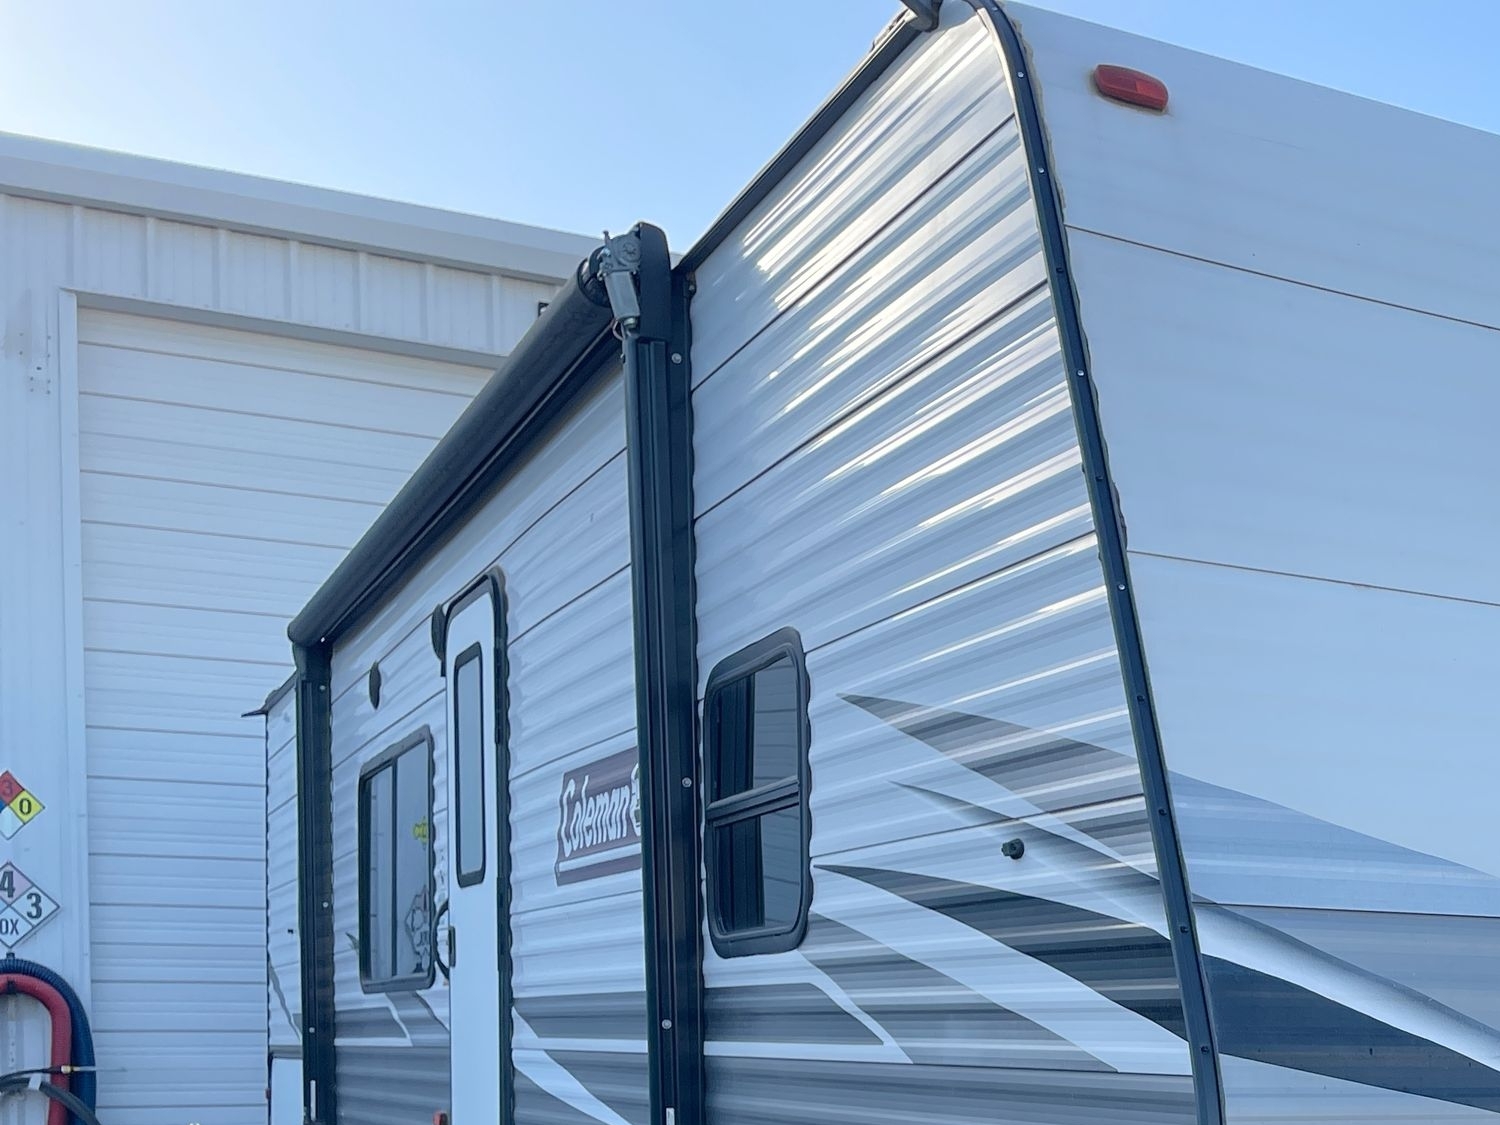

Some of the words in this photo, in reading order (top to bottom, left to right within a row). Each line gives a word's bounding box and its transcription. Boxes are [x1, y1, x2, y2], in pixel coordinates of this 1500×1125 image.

[19, 798, 32, 815] 0
[561, 775, 631, 858] Coleman
[0, 871, 15, 898] 4
[27, 893, 42, 919] 3
[0, 918, 19, 935] OX
